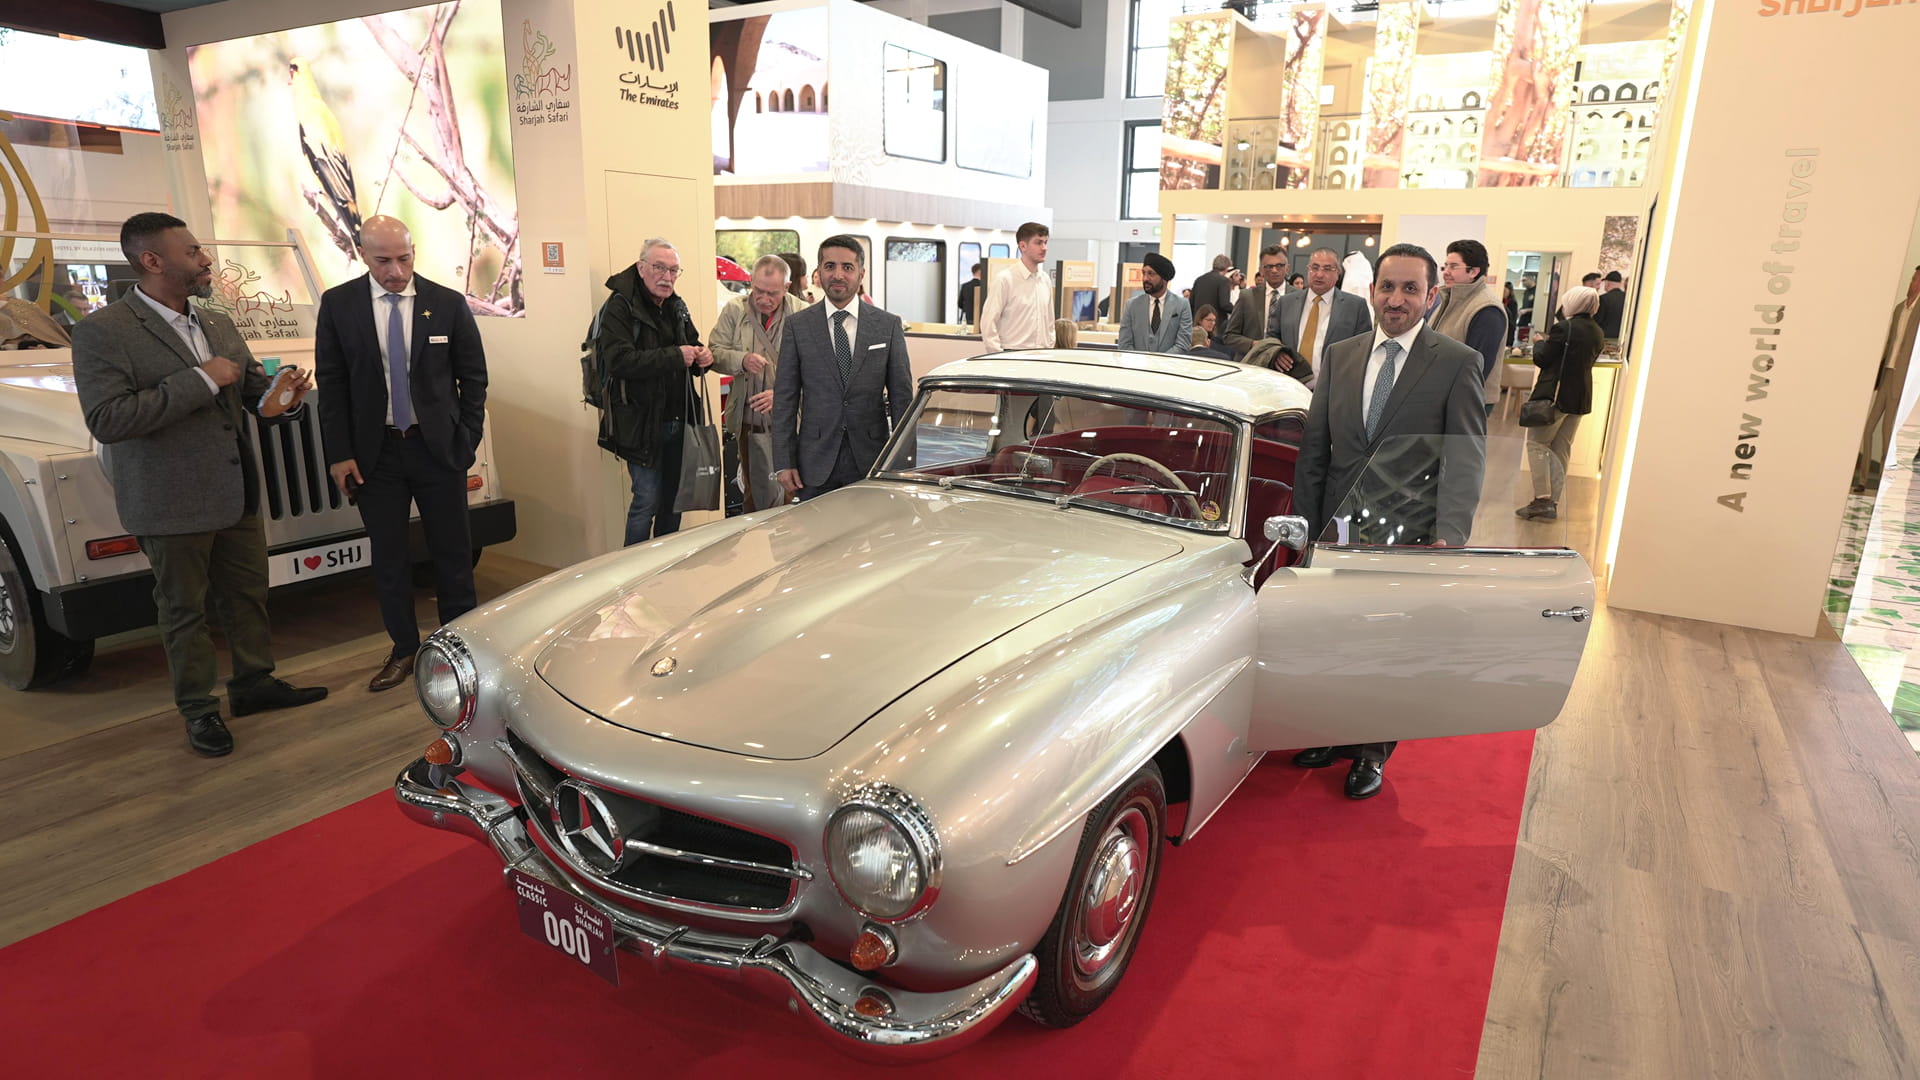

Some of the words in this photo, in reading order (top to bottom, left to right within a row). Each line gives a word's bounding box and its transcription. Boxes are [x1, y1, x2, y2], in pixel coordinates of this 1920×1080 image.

[1757, 0, 1918, 17] Sharj
[619, 71, 679, 98] الإمارات
[516, 99, 543, 115] الشارقة
[545, 98, 570, 113] سفاري
[619, 88, 637, 103] The
[639, 92, 679, 110] Emirates
[519, 114, 545, 127] Sharjah
[547, 111, 569, 123] Safari
[1770, 147, 1821, 254] travel
[1762, 261, 1795, 295] of
[239, 329, 262, 341] rjah
[265, 328, 300, 339] Safari
[259, 316, 299, 330] سفاري
[1745, 303, 1786, 402] world
[1730, 412, 1763, 480] new
[1716, 491, 1747, 513] A
[293, 557, 300, 575] I
[326, 544, 362, 568] SHJ
[516, 886, 548, 908] CLASSIC
[573, 902, 603, 928] الشارقة
[543, 911, 591, 965] 000
[575, 915, 604, 941] SHARJAH
